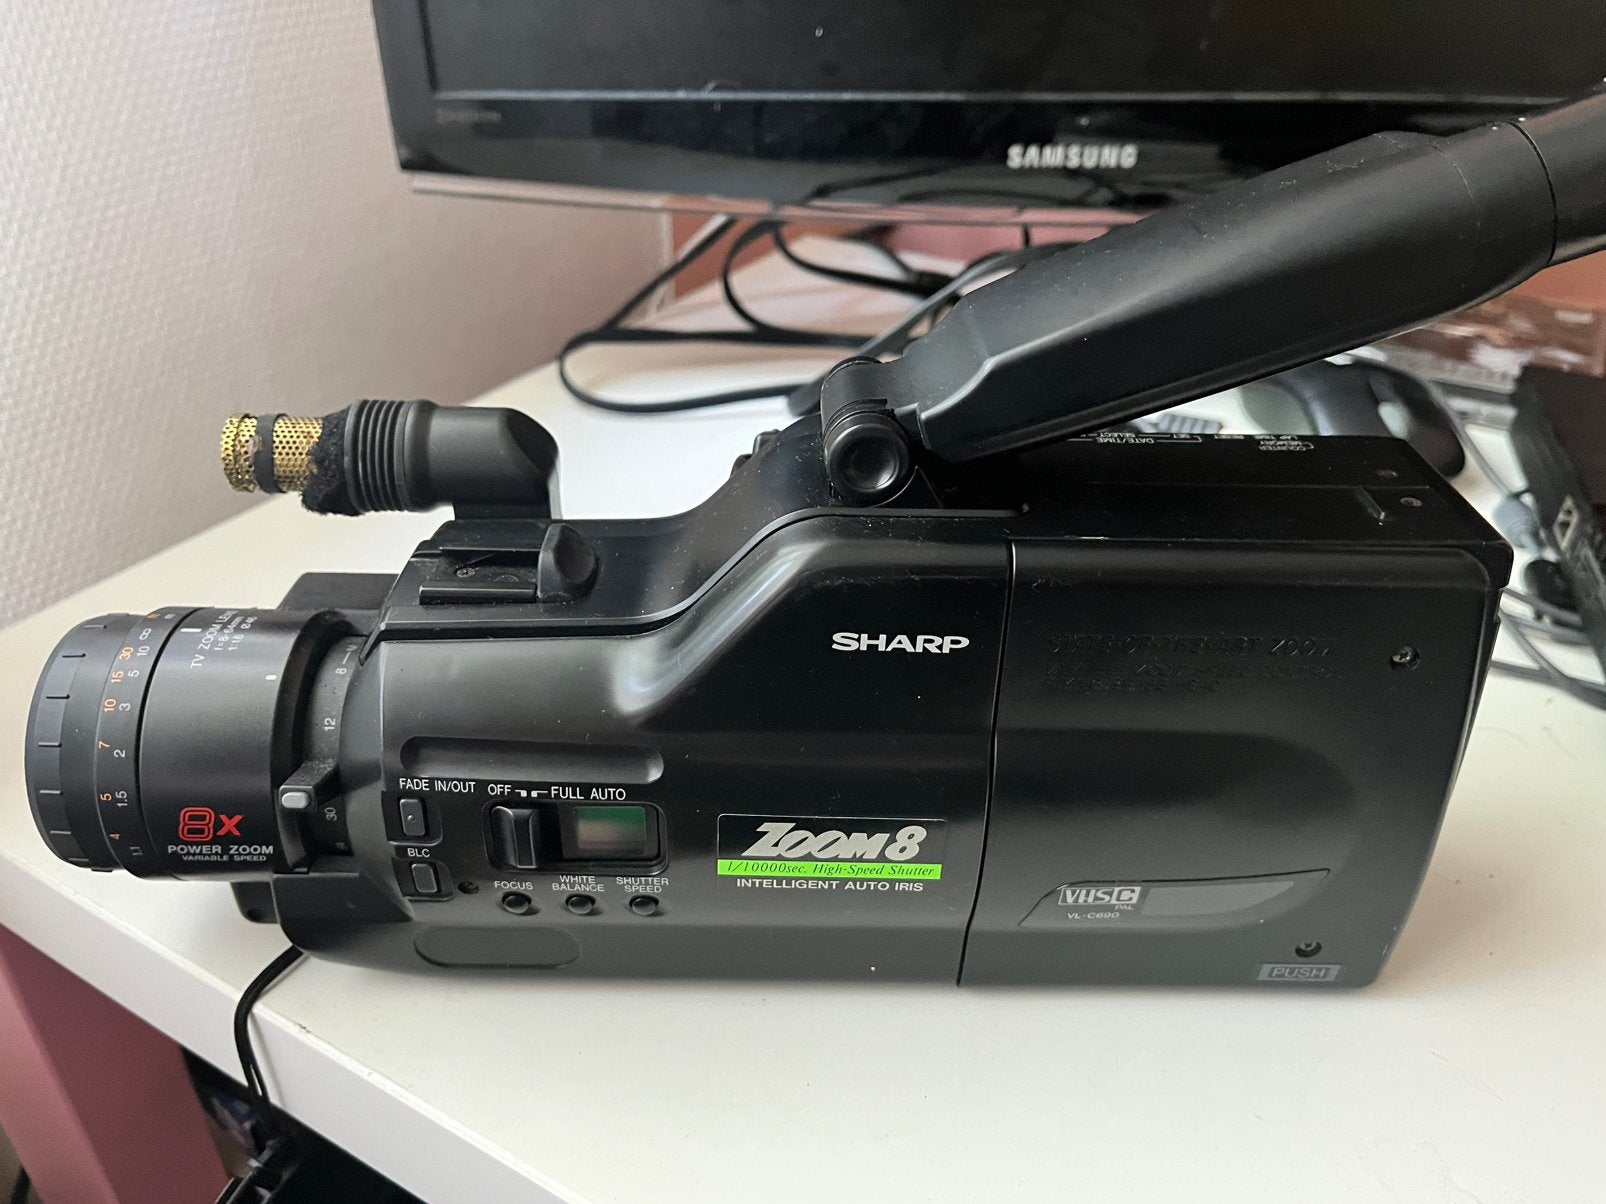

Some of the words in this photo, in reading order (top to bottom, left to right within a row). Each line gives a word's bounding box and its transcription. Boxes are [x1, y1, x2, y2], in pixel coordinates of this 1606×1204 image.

[1006, 143, 1138, 169] SAMSUNG
[831, 632, 970, 654] SHARP
[119, 646, 134, 660] 30
[137, 645, 150, 657] 10
[190, 654, 205, 669] TV
[111, 670, 124, 683] 15
[128, 670, 140, 678] 5
[104, 698, 117, 712] 10
[119, 702, 131, 711] 3
[324, 717, 336, 731] 12
[98, 740, 110, 749] 7
[114, 749, 126, 758] 2
[399, 778, 430, 792] FADE
[434, 780, 476, 793] IN/OUT
[100, 793, 112, 801] 5
[487, 784, 512, 796] OFF
[551, 786, 585, 799] FULL
[590, 788, 626, 800] AUTO
[116, 790, 128, 807] 1.5
[325, 807, 337, 820] 30
[741, 822, 890, 860] ZOOM
[884, 825, 927, 861] 8
[167, 844, 222, 854] POWER
[229, 845, 274, 854] ZOOM
[407, 847, 431, 858] BLC
[727, 861, 807, 874] 1/10000sec.
[813, 864, 885, 876] High-Speed
[888, 865, 935, 876] Shutter
[494, 880, 533, 890] FOCUS
[559, 874, 596, 884] WHITE
[616, 876, 669, 886] SHUTTER
[736, 878, 840, 890] INTELLIGENT
[844, 881, 890, 891] AUTO
[894, 882, 924, 892] IRIS
[552, 882, 605, 892] BALANCE
[624, 884, 662, 893] SPEED
[1272, 967, 1326, 979] PUSH
